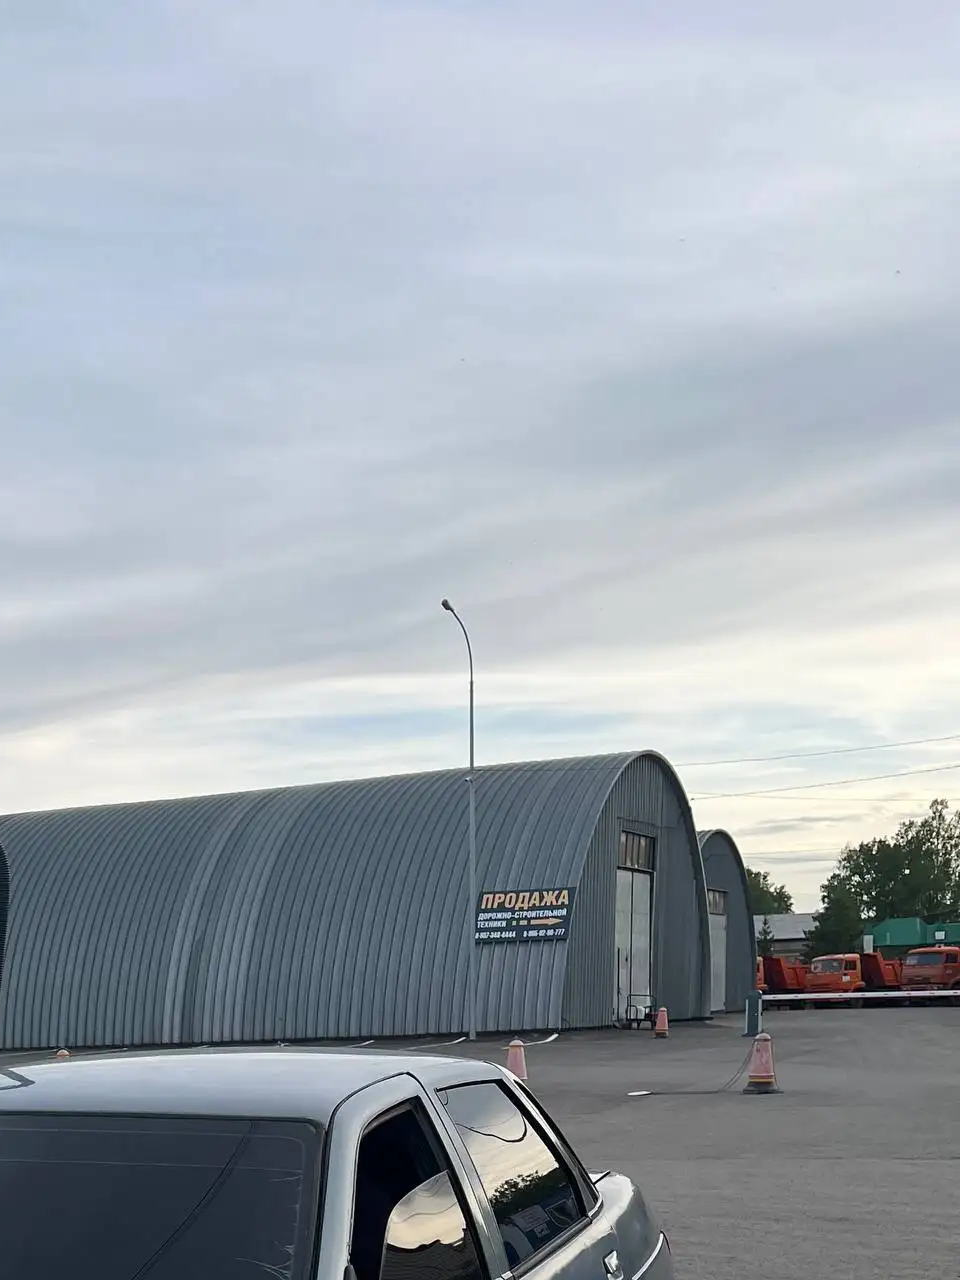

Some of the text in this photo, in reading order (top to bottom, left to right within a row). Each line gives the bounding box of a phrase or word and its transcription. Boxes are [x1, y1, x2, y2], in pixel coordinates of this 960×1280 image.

[481, 889, 569, 910] ПРОДАЖА
[478, 908, 567, 921] ДОРОЖНО-СТРОИТЕЛЬНОЙ
[477, 920, 507, 928] ТЕХНИКИ
